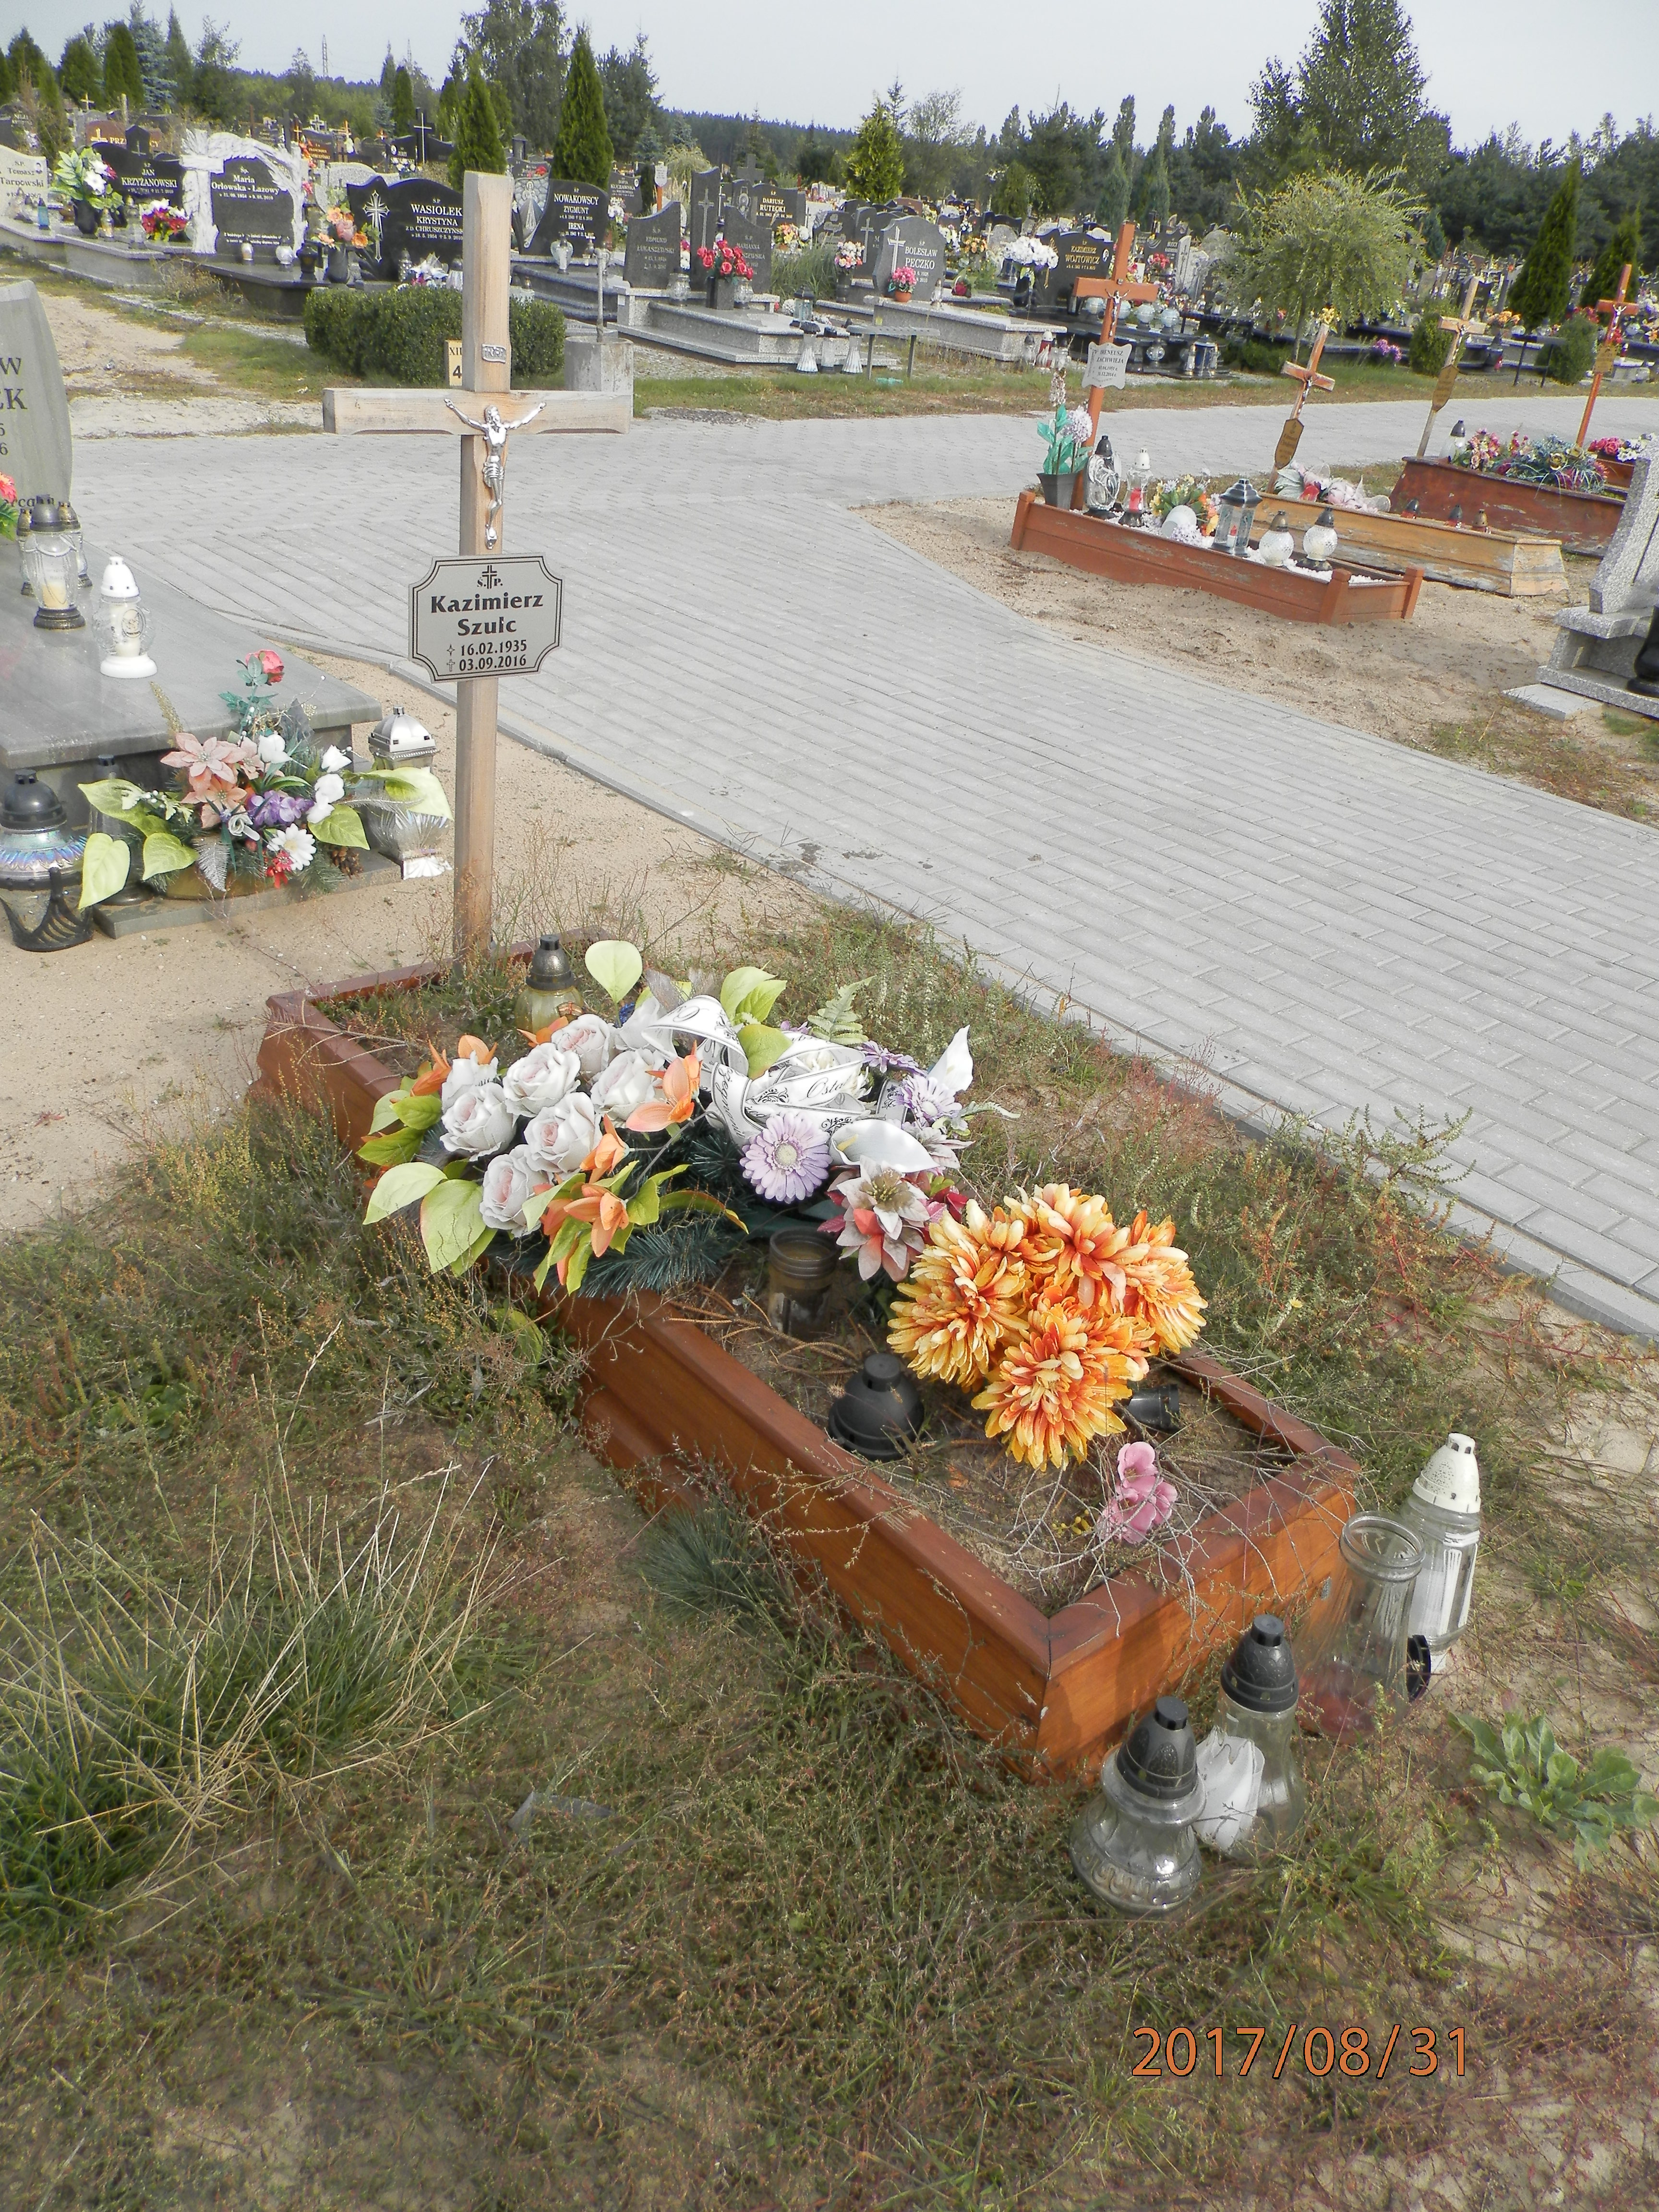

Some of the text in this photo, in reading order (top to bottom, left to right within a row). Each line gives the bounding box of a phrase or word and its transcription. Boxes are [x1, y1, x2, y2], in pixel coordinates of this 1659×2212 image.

[233, 175, 255, 183] Maria
[554, 193, 599, 205] NOWAKOWSCY
[762, 197, 784, 205] DARIUSZ
[564, 205, 589, 214] ZYGMUNT
[760, 204, 786, 213] RUTECKI
[417, 216, 458, 226] KRYSTYNA
[568, 222, 584, 230] IRENA
[431, 592, 543, 613] Kazimierz
[457, 616, 517, 636] Szulc
[461, 639, 527, 656] 16.02.1935
[459, 654, 526, 672] 03.09.2016
